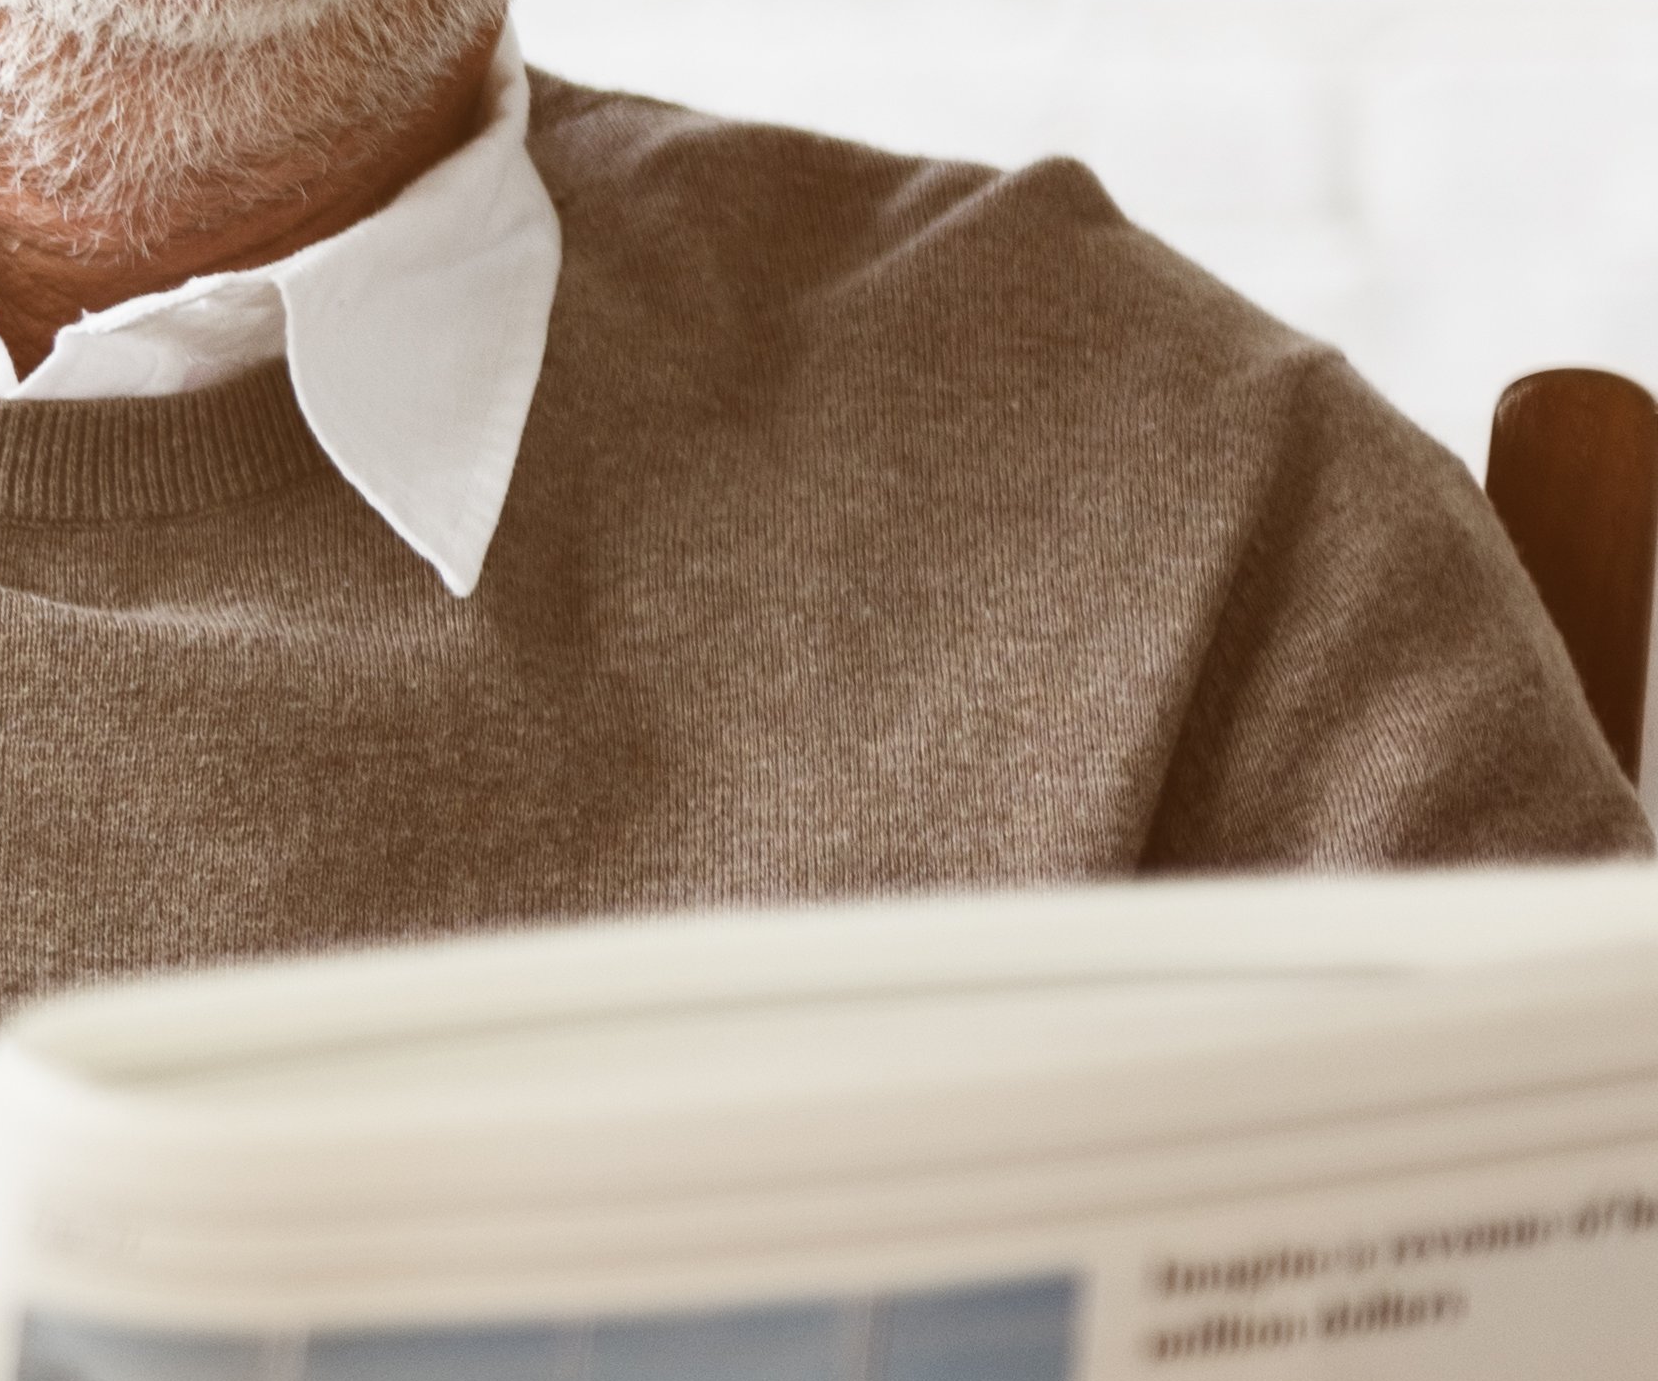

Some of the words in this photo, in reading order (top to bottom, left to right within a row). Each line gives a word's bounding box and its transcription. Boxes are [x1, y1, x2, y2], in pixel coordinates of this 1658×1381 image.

[1150, 1244, 1332, 1296] Imagine
[1147, 1314, 1312, 1364] million
[1319, 1288, 1473, 1340] dollars
